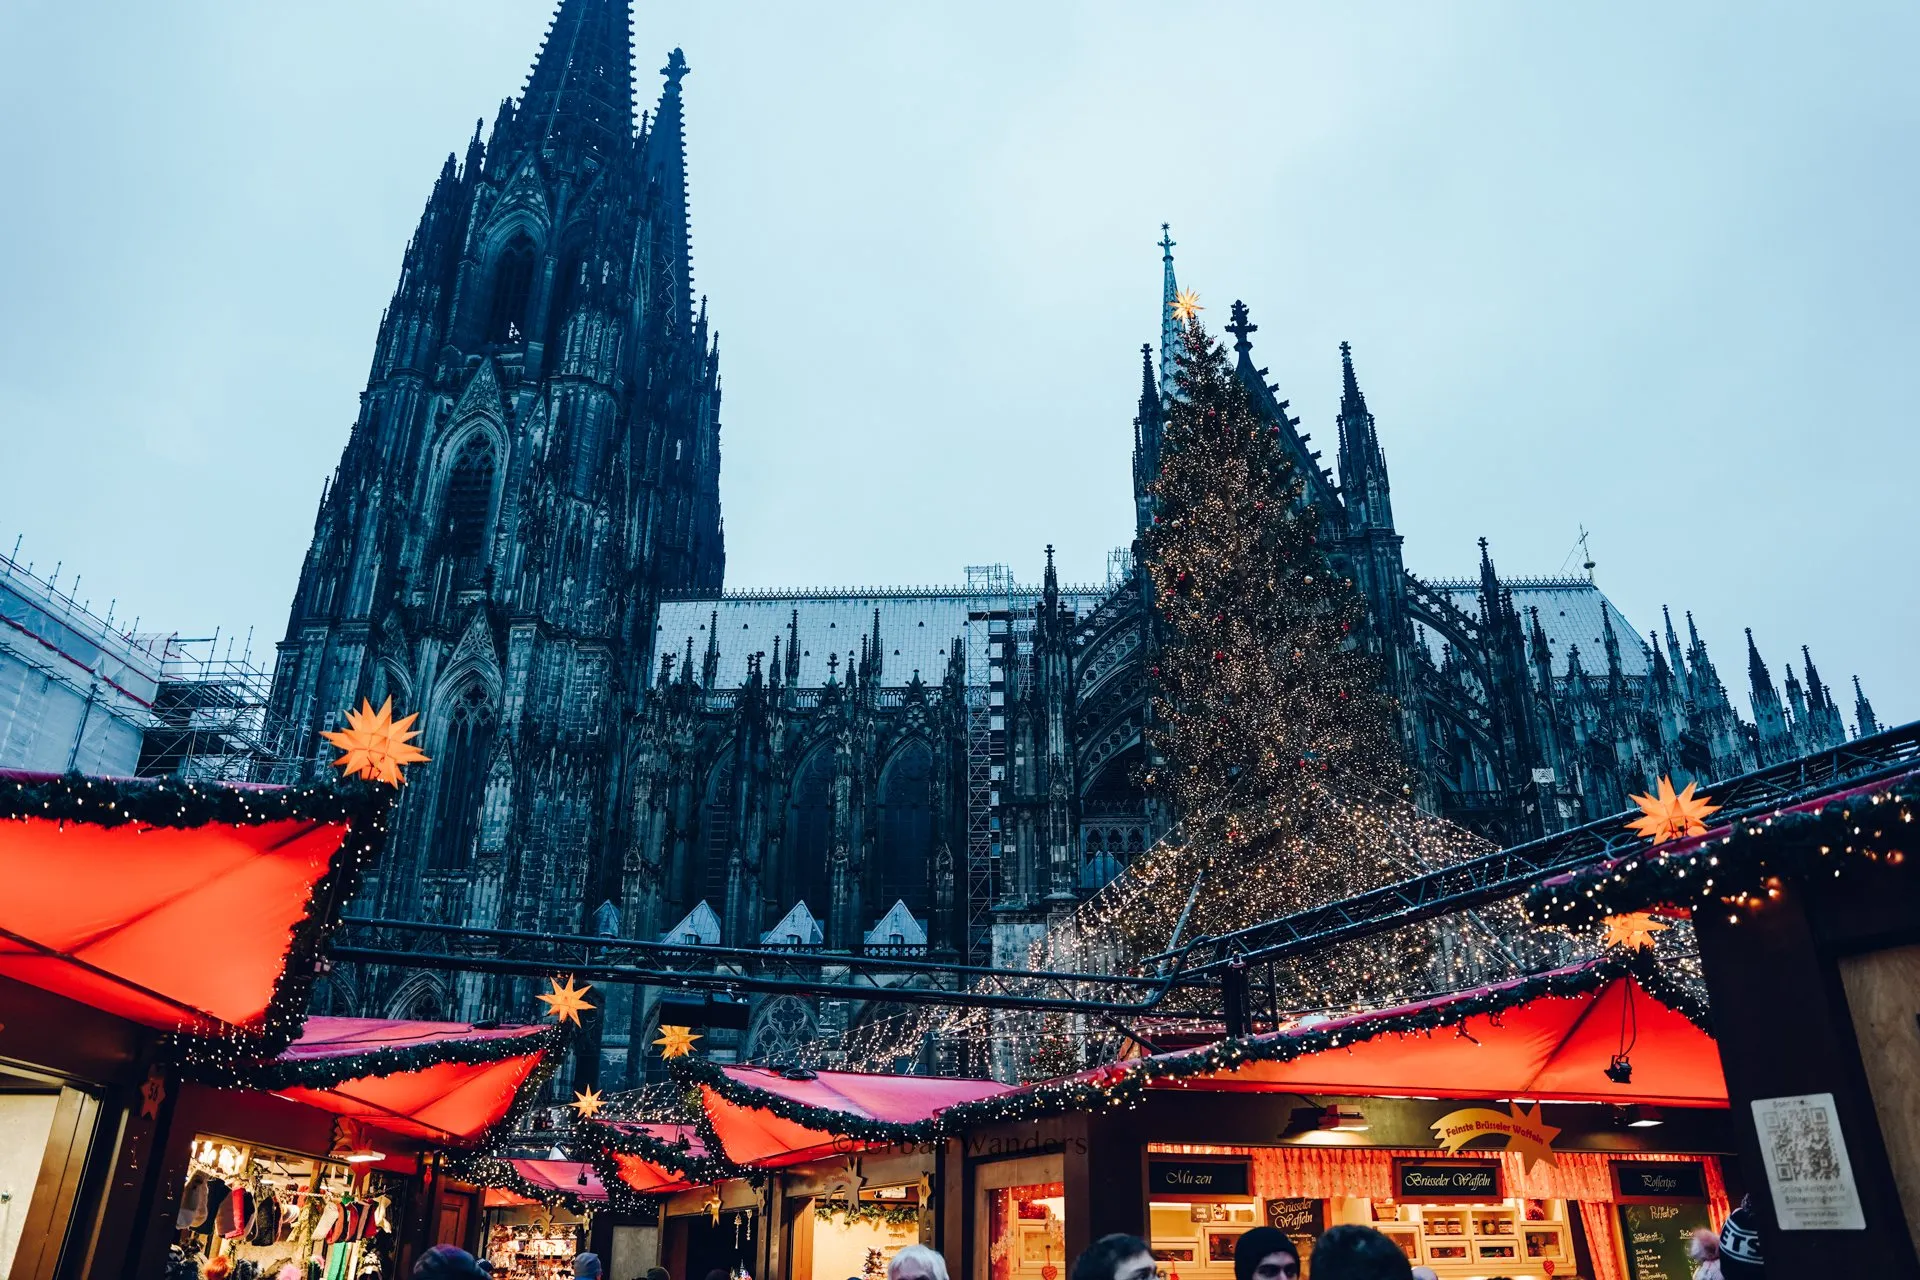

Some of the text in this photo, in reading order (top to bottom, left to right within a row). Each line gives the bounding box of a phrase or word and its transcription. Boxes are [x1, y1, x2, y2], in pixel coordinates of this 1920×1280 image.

[1445, 1121, 1544, 1146] Feinste Brüsseler Waffeln
[1404, 1172, 1491, 1191] Brüsseler Waffeln
[1640, 1174, 1677, 1192] Poffertjes
[1269, 1198, 1313, 1216] Brüsseler
[1274, 1211, 1313, 1231] Waffeln
